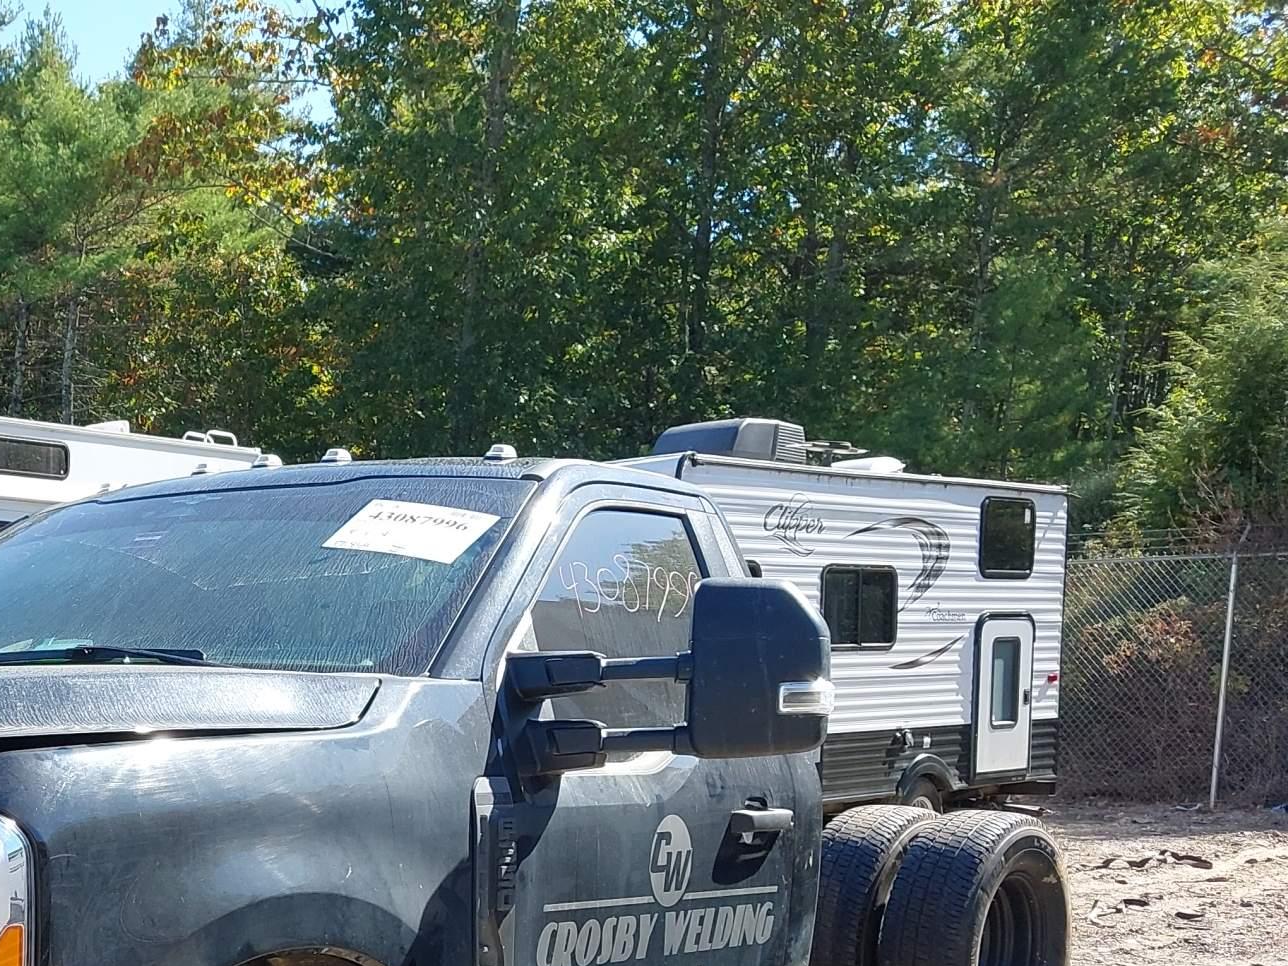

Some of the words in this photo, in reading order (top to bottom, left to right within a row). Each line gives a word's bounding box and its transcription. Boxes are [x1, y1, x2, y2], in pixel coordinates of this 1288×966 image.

[369, 511, 470, 531] 43087996
[763, 500, 827, 541] Clipper
[650, 831, 693, 892] CW
[662, 901, 775, 957] WELDING
